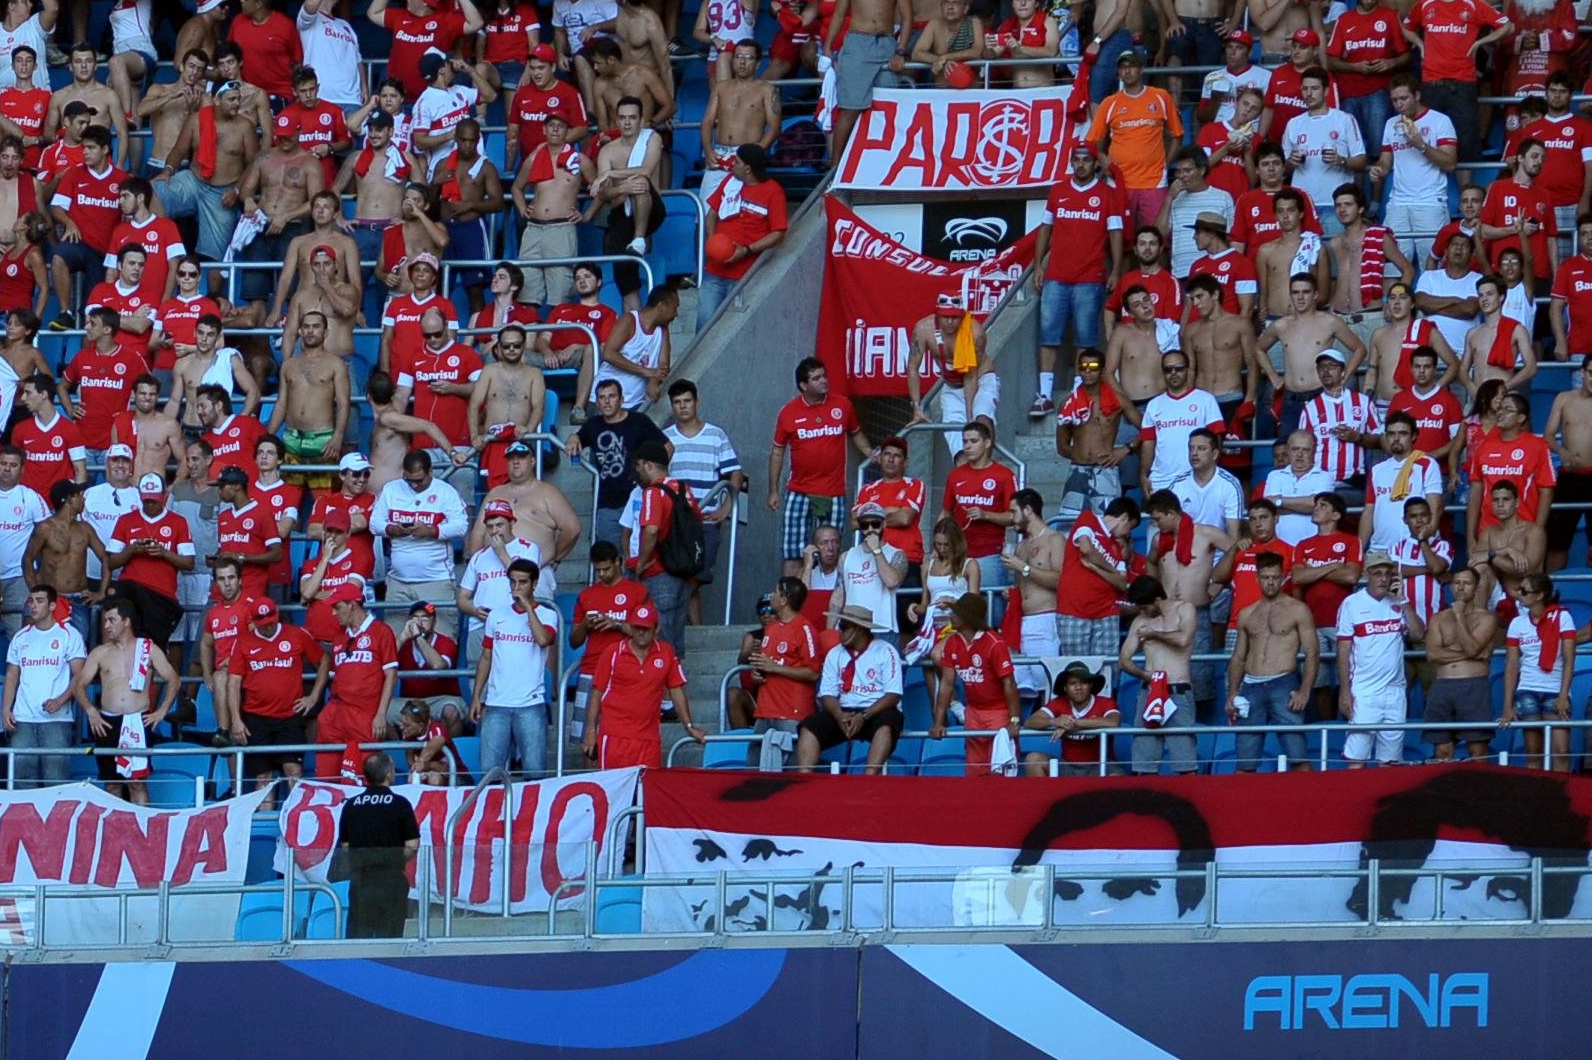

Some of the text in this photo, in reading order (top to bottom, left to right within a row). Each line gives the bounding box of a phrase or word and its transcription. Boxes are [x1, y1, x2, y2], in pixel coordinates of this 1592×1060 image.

[710, 2, 741, 32] 93
[395, 30, 435, 42] Banrisul
[1345, 38, 1386, 51] Banrisul
[299, 132, 333, 142] anrisul
[1544, 138, 1574, 149] nrisul
[78, 195, 119, 207] Banrisul
[1504, 196, 1517, 207] 10
[1057, 208, 1100, 220] Banrisul
[1251, 206, 1260, 216] 6
[949, 249, 996, 261] ARENA
[396, 313, 421, 324] Banri
[80, 377, 123, 388] Banrisul
[416, 371, 459, 383] Banrisul
[1155, 417, 1197, 429] Banrisul
[798, 425, 842, 439] Banrisul
[213, 442, 240, 456] nrisul
[1482, 464, 1523, 475] Banrisul
[20, 657, 59, 668] Banrisul
[353, 794, 393, 806] APOIO
[1244, 973, 1489, 1030] ARENA
